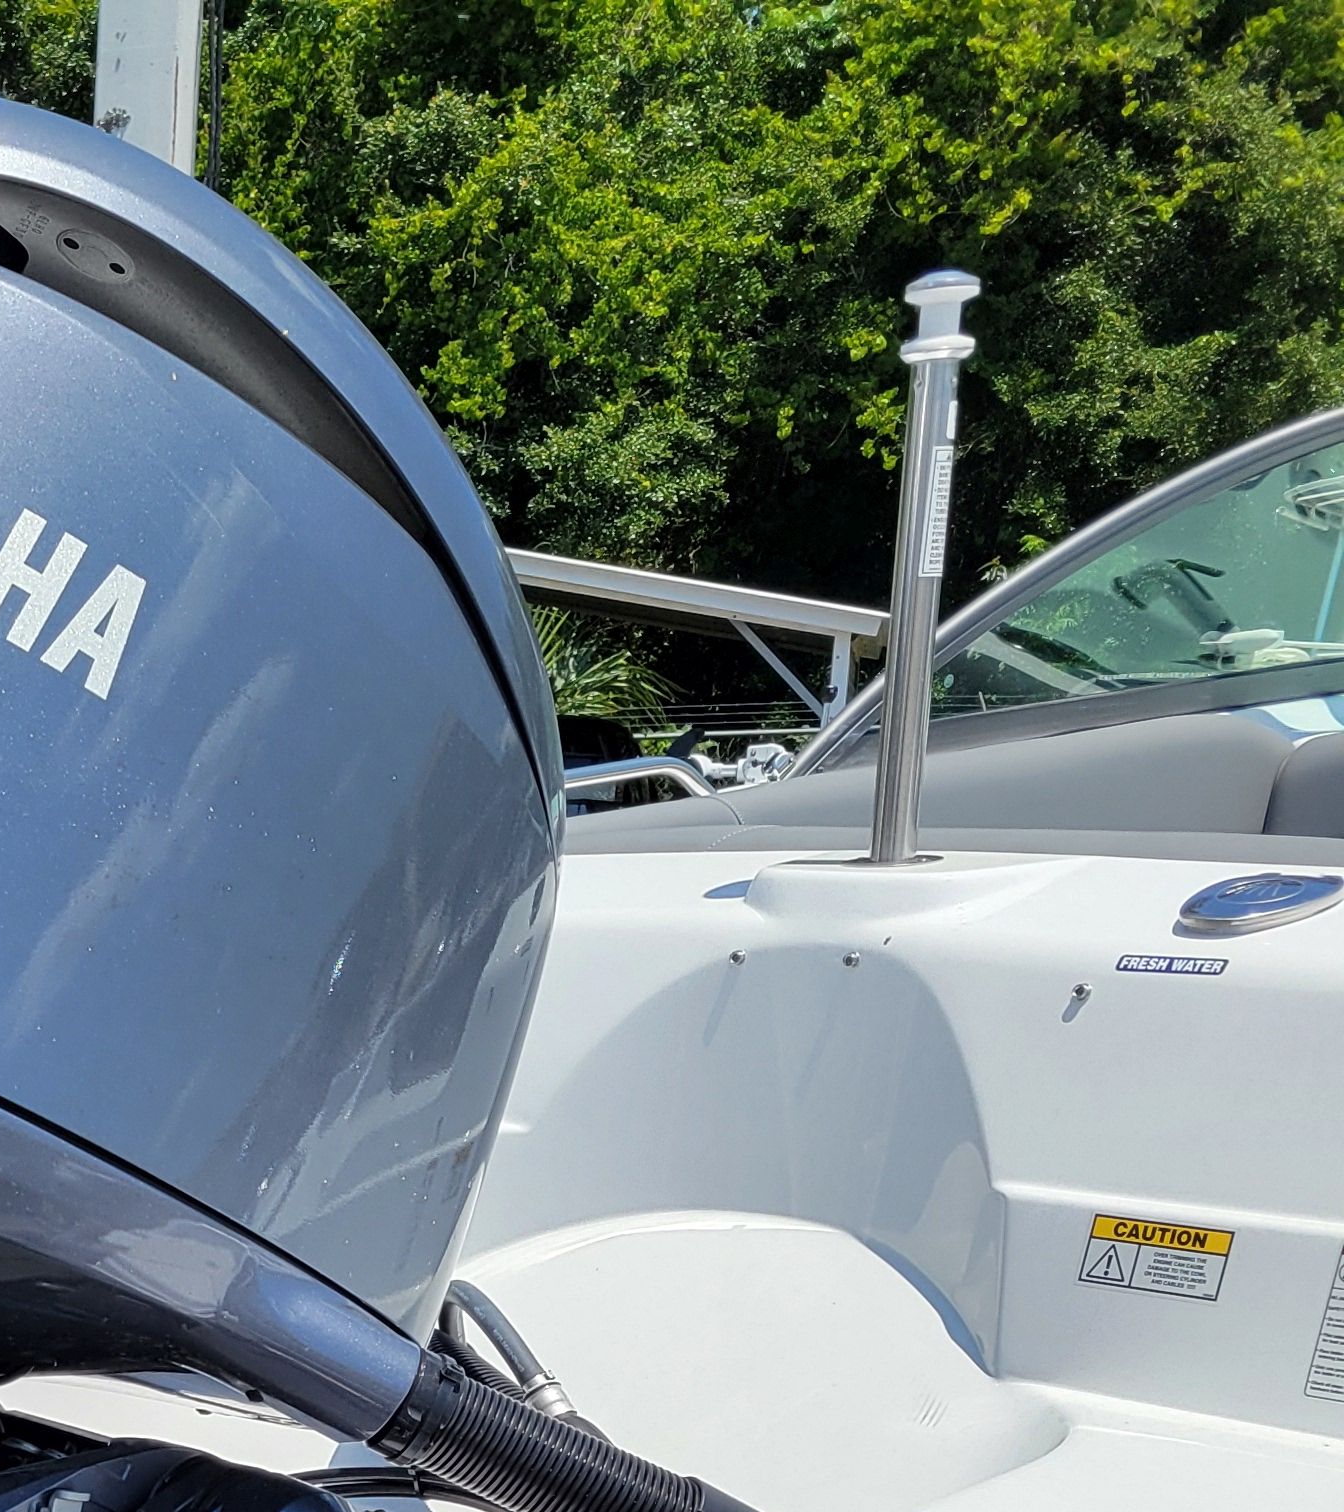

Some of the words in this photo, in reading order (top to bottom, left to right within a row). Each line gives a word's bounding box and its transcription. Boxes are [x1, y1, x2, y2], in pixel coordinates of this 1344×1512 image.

[1119, 957, 1169, 970] FRESH
[1171, 959, 1225, 973] WATER
[1113, 1221, 1209, 1248] CAUTION
